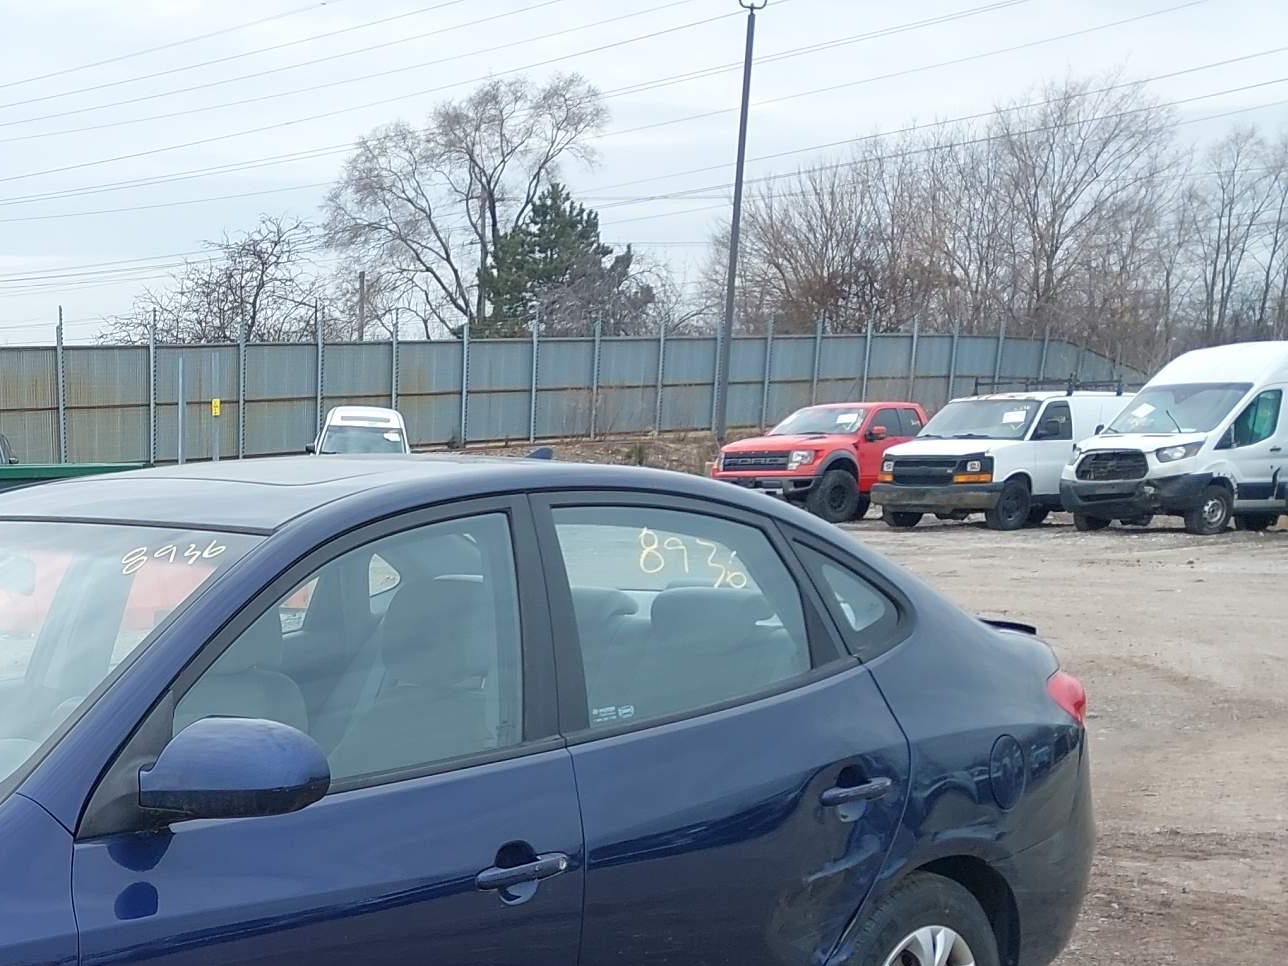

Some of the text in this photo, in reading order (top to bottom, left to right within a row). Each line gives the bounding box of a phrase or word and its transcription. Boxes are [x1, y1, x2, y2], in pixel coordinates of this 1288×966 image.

[724, 457, 787, 465] FORD
[121, 539, 226, 575] 8936
[639, 526, 747, 589] 8936
